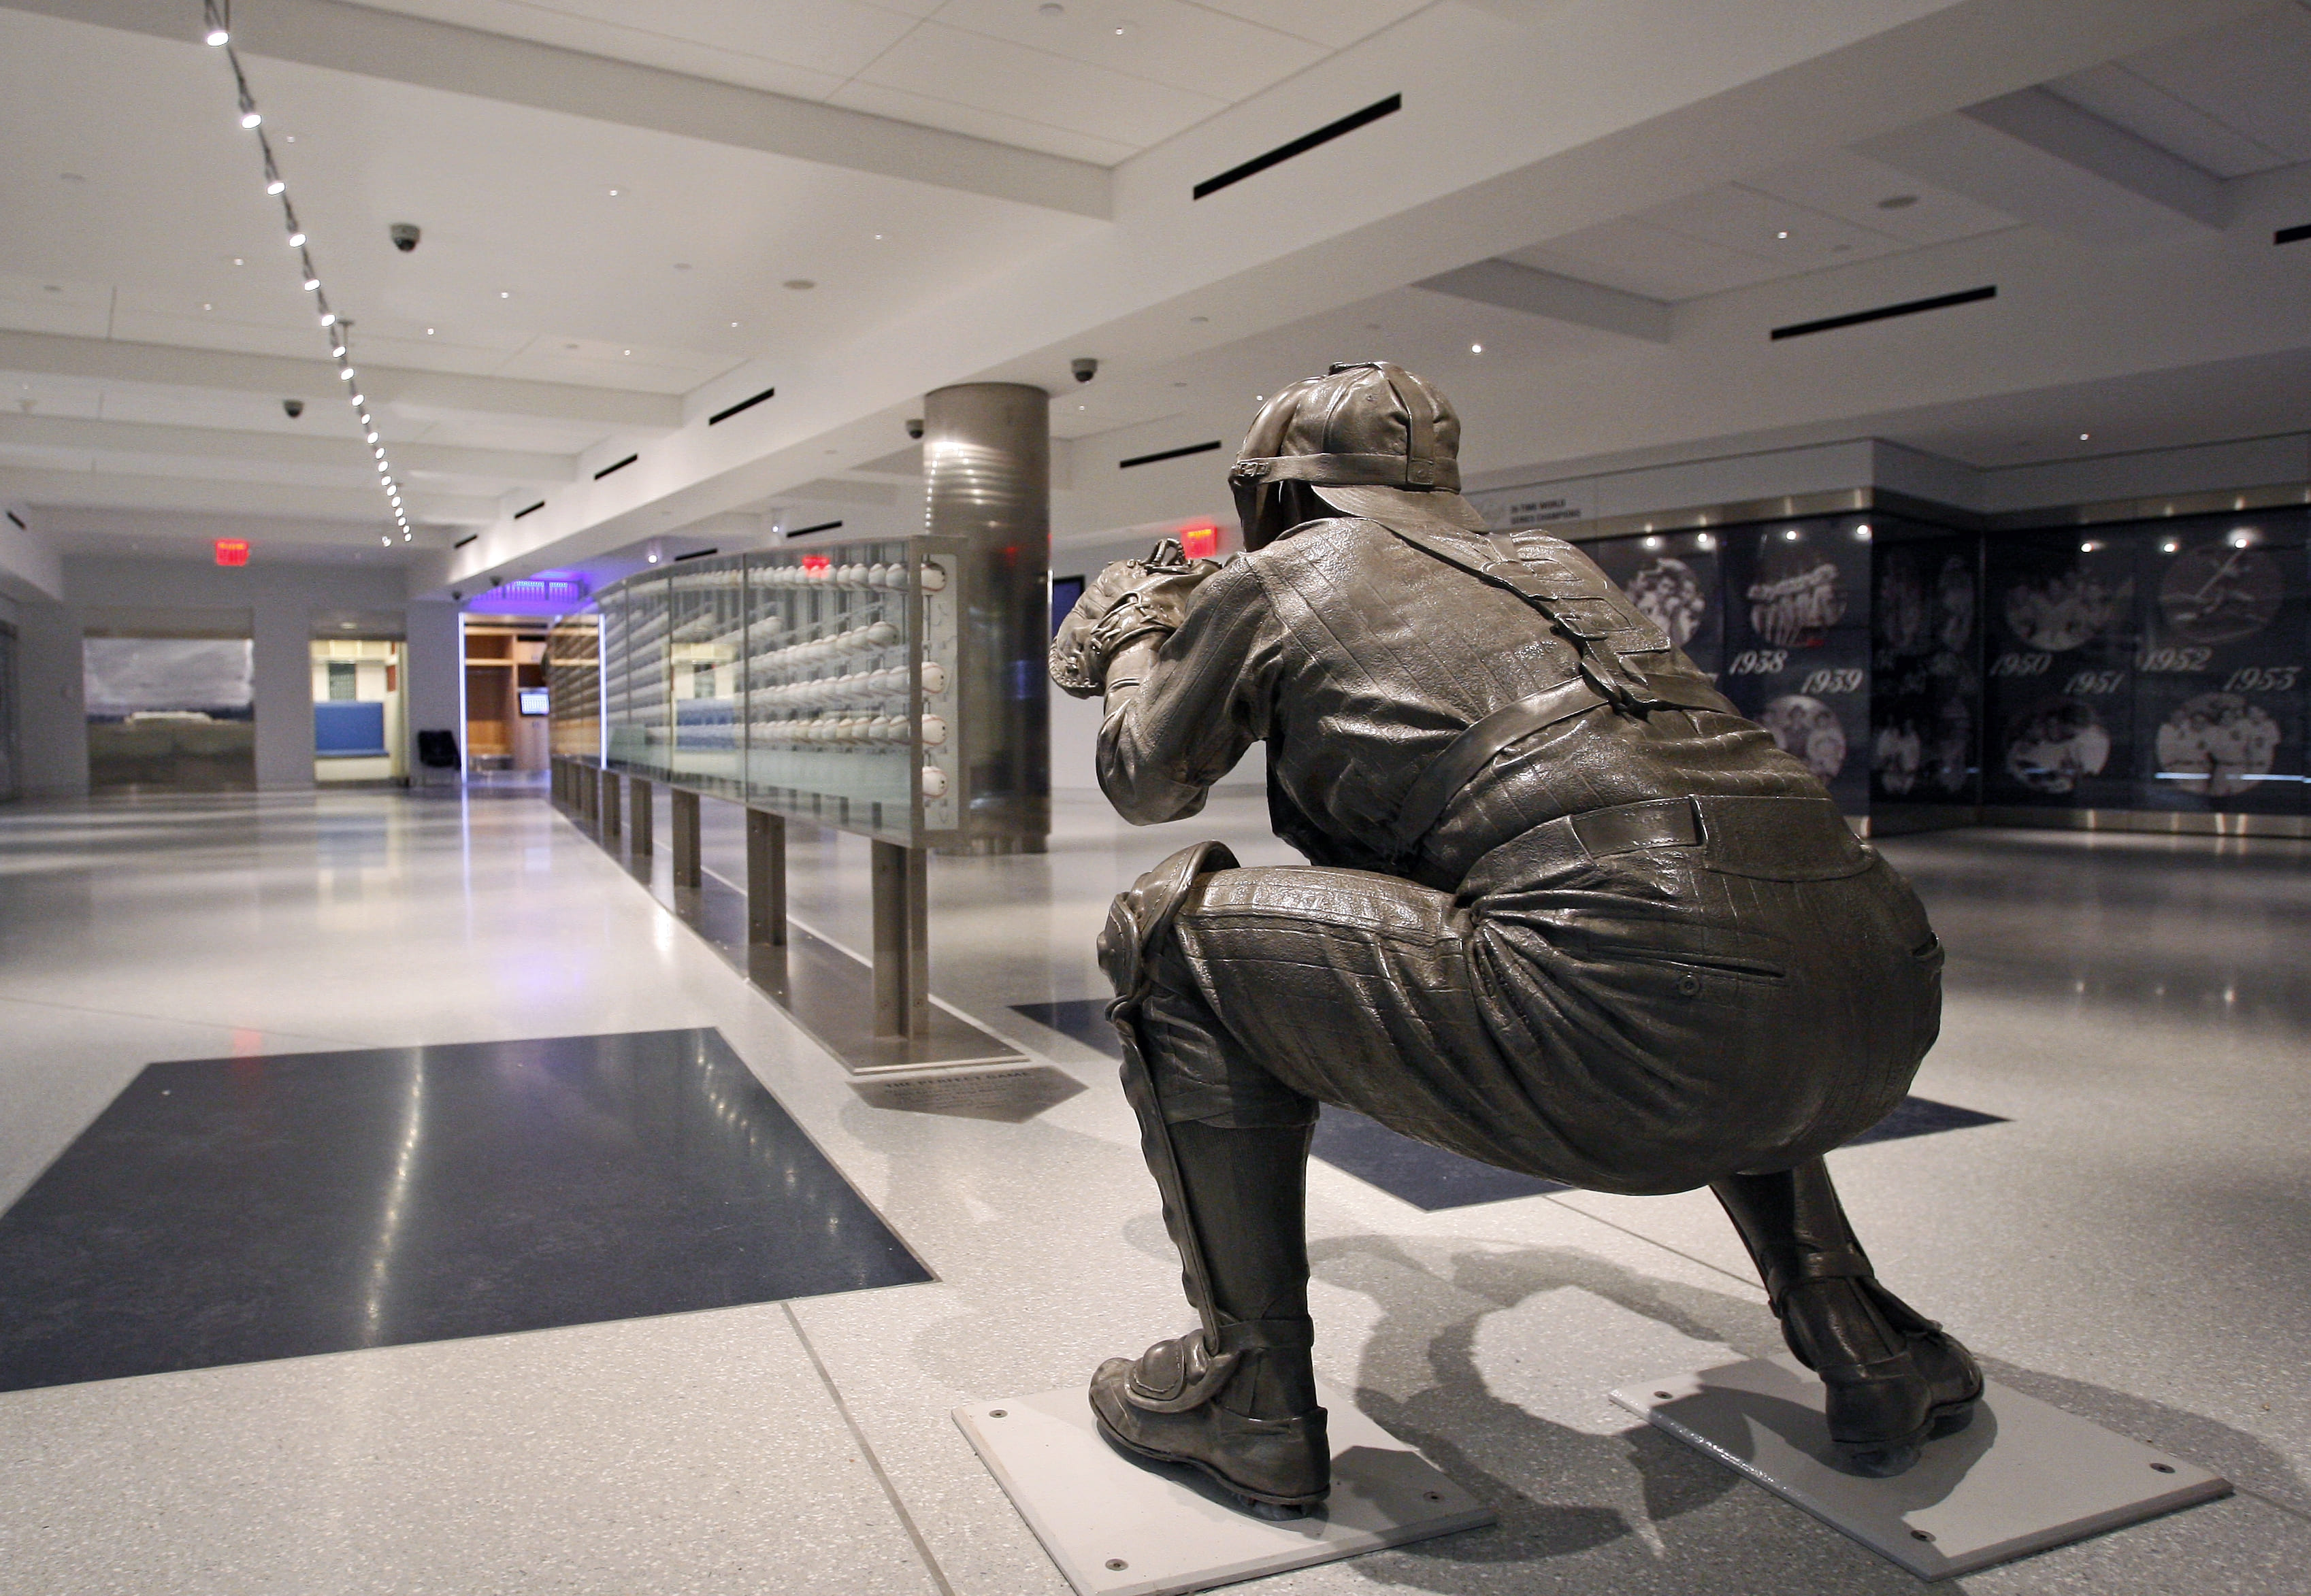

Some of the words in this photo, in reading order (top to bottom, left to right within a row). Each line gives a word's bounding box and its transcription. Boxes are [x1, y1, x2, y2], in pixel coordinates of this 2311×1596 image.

[1510, 514, 1535, 525] SERIES
[1537, 508, 1581, 520] CHAMPIONS
[1539, 499, 1567, 510] WORLD
[1728, 649, 1788, 675] 1938
[1988, 652, 2052, 677] 1950
[2140, 647, 2214, 671] 1952
[1801, 668, 1863, 694] 1939
[2064, 670, 2125, 695] 1951
[2221, 666, 2303, 692] 1953
[917, 1075, 981, 1085] PERFECT
